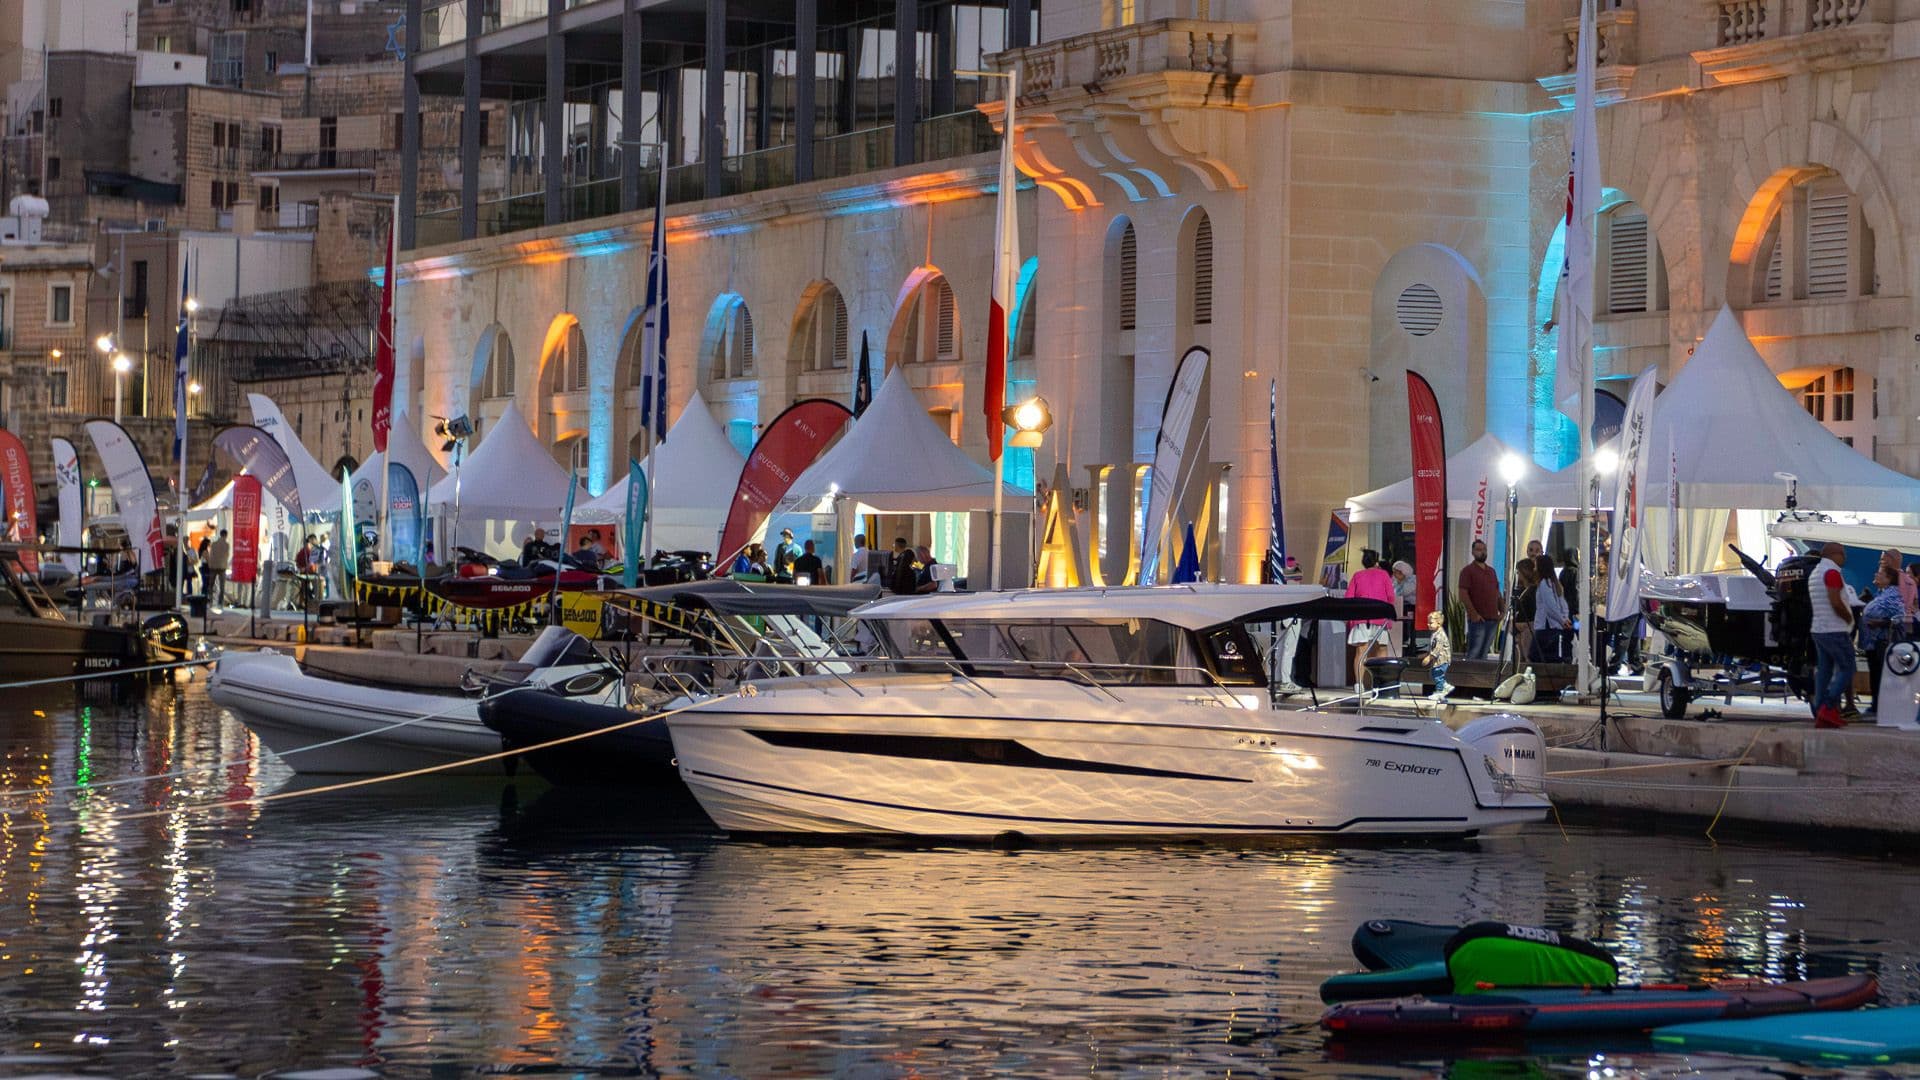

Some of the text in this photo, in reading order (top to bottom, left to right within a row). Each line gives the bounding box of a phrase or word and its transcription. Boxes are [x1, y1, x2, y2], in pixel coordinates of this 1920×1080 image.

[758, 452, 790, 483] SUCCEED
[1037, 462, 1234, 588] AUM
[1503, 747, 1536, 760] YAMAHA
[1384, 760, 1444, 776] Explorer
